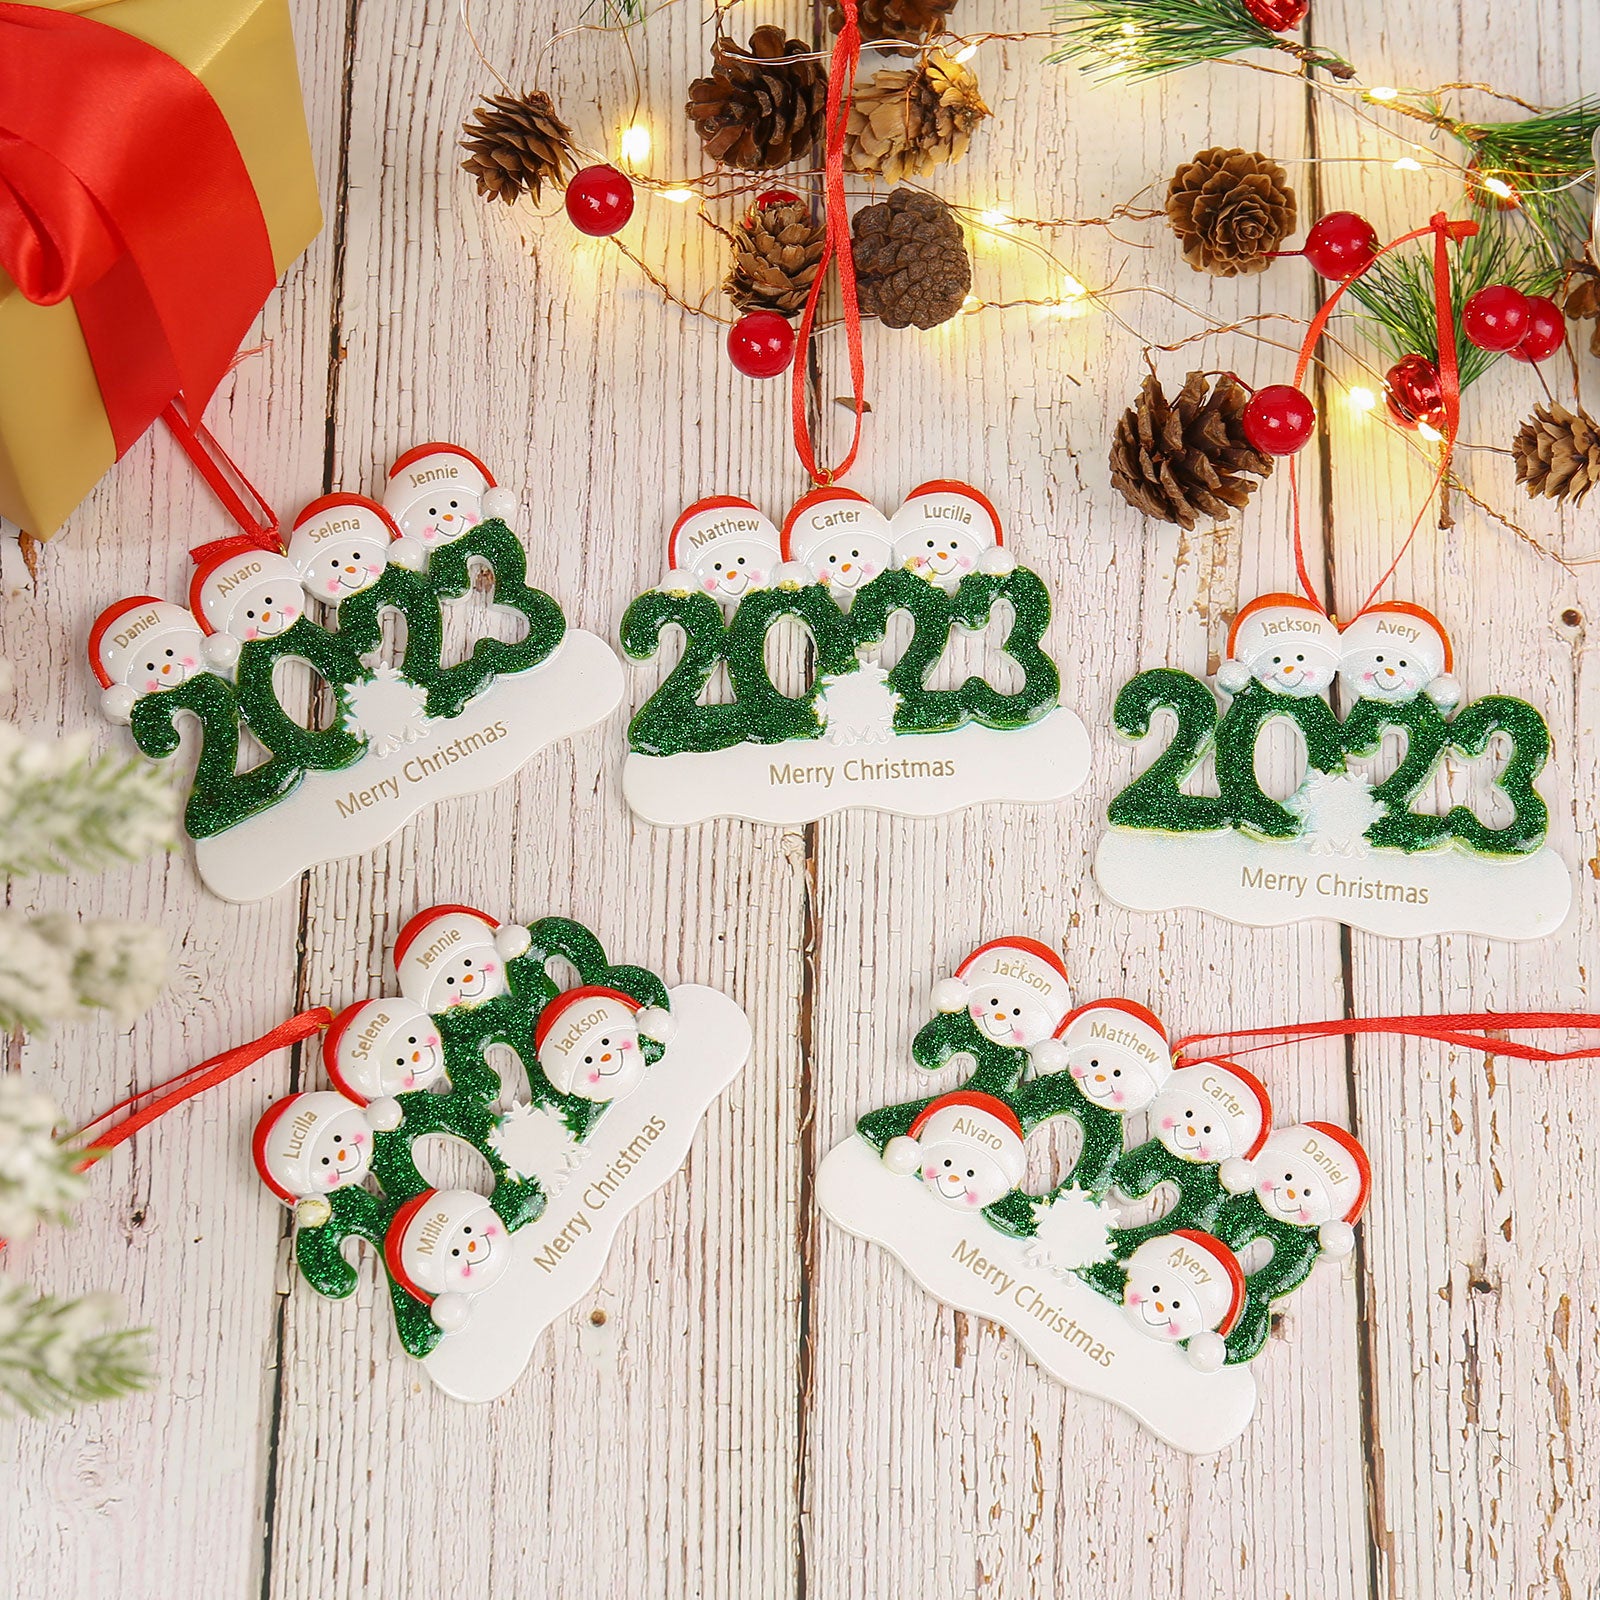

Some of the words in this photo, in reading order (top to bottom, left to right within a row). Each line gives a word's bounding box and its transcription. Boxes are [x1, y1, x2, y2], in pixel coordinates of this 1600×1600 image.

[409, 464, 459, 489] Jennie
[308, 516, 361, 544] Selena
[688, 517, 761, 550] Matthew
[811, 509, 861, 532] Carter
[923, 503, 972, 526] Lucilla
[215, 559, 263, 599] Alvaro
[113, 610, 162, 650] Daniel
[1261, 617, 1322, 638] Jackson
[1375, 619, 1421, 643] Avery
[130, 518, 567, 840] 2023
[619, 566, 1061, 758] 2023
[335, 776, 402, 820] Merry
[402, 720, 508, 784] Christmas
[769, 763, 836, 789] Merry
[843, 758, 956, 784] Christmas
[1107, 667, 1551, 858] 2023
[1240, 866, 1308, 898] Merry
[1315, 874, 1430, 906] Christmas
[416, 927, 462, 970] Jennie
[992, 958, 1053, 997] Jackson
[352, 1012, 391, 1061] Selena
[554, 1006, 609, 1057] Jackson
[1090, 1021, 1161, 1064] Matthew
[1201, 1076, 1246, 1120] Carter
[283, 1109, 318, 1161] Lucilla
[952, 1117, 1004, 1151] Alvaro
[1301, 1138, 1348, 1186] Daniel
[533, 1212, 592, 1275] Merry
[583, 1114, 667, 1210] Christmas
[416, 1211, 450, 1256] Millie
[1170, 1245, 1213, 1285] Avery
[950, 1238, 1013, 1298] Merry
[1013, 1285, 1116, 1370] Christmas
